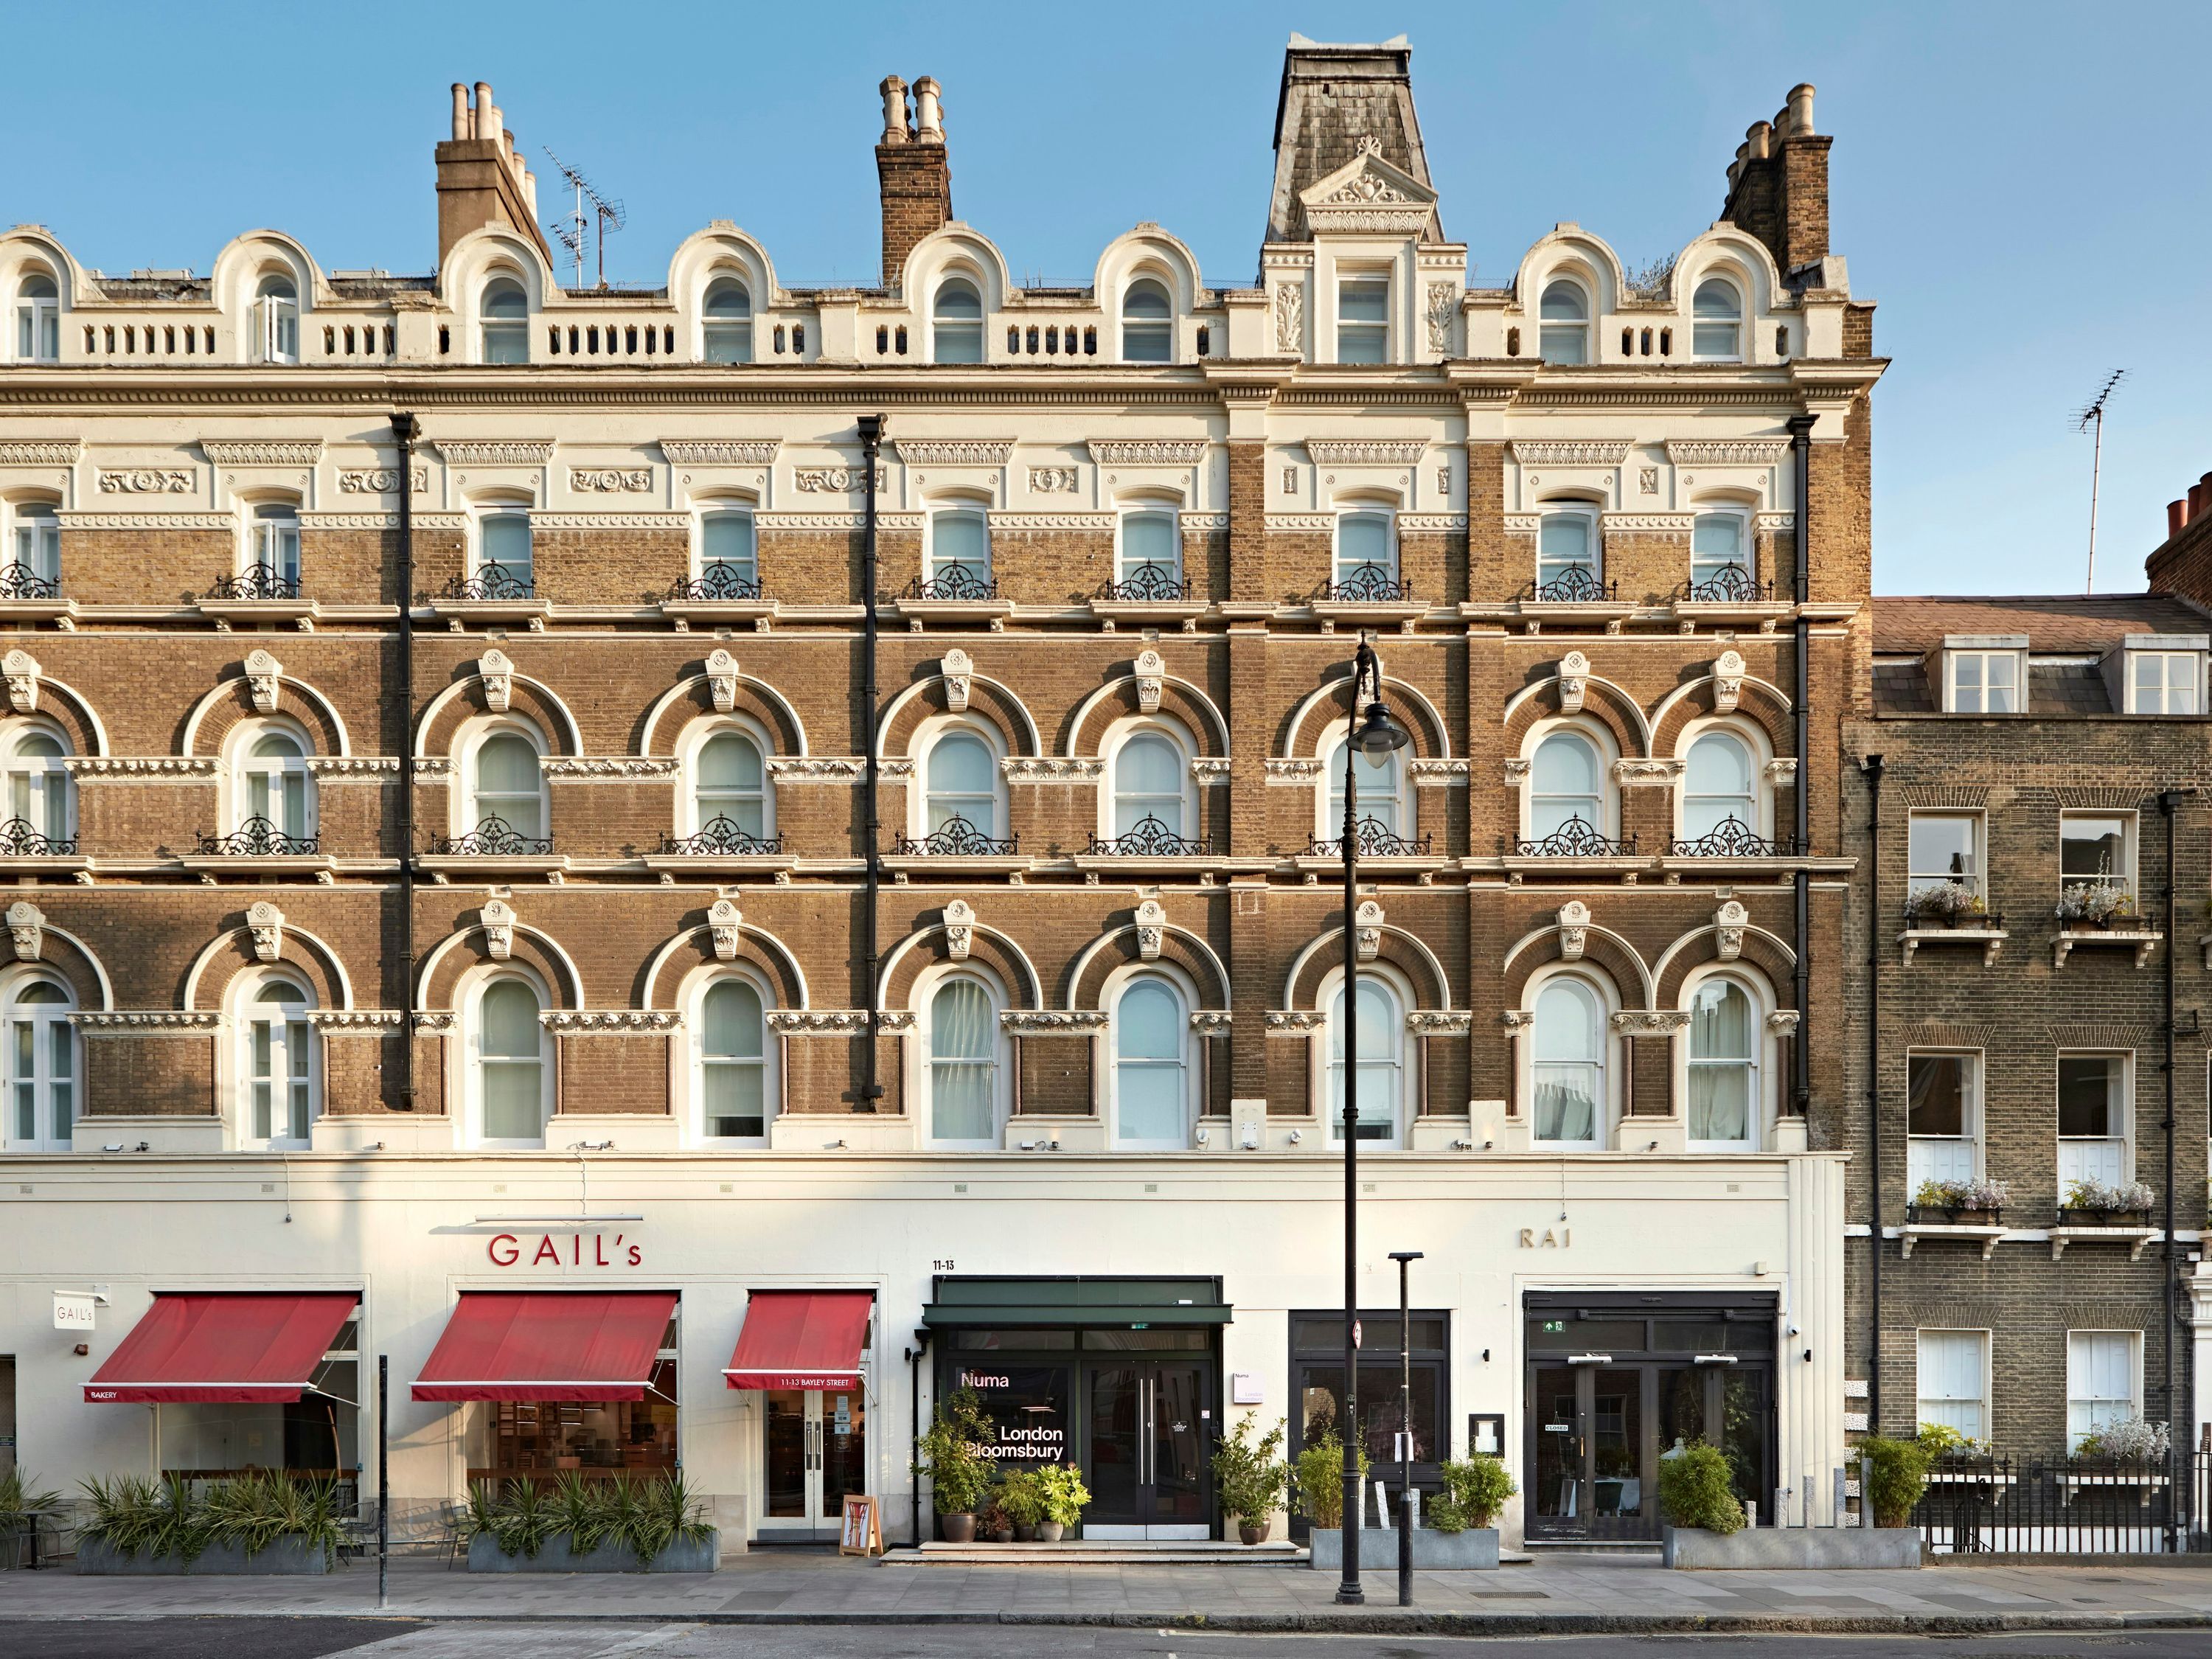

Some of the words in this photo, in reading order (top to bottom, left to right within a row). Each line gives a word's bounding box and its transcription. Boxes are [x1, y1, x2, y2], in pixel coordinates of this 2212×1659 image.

[1520, 1228, 1570, 1248] RAI
[489, 1233, 641, 1266] GAIL's
[933, 1259, 955, 1270] 11-13
[57, 1307, 92, 1321] GAIL's
[961, 1372, 1009, 1387] Numa
[1001, 1426, 1063, 1441] London
